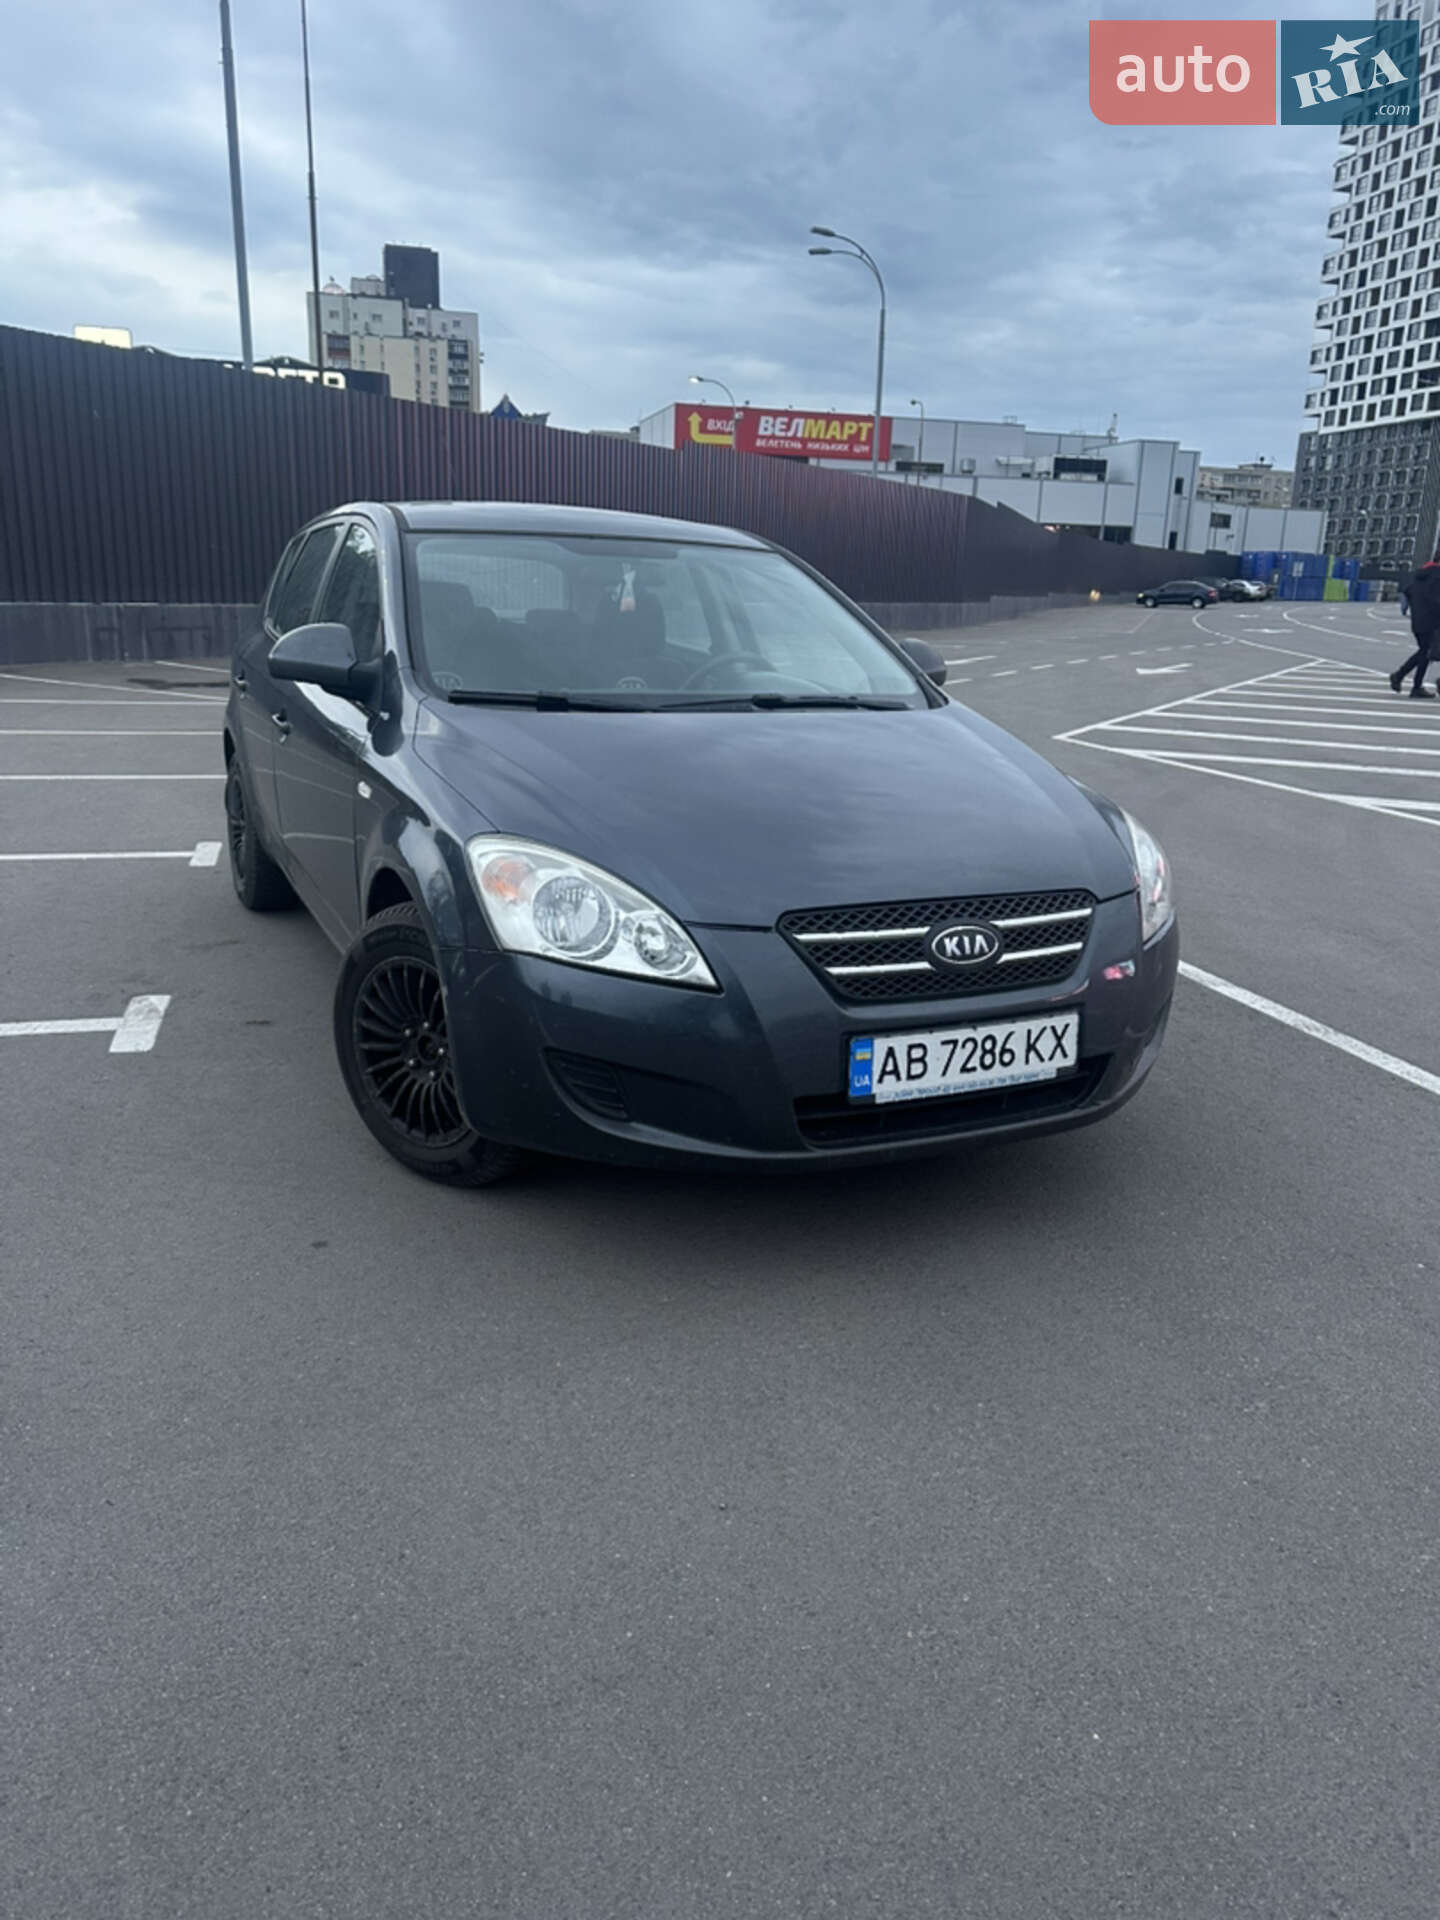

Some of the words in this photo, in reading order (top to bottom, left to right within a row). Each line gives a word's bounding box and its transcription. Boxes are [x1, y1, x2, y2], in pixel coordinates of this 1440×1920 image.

[758, 415, 873, 442] ВЕЛМАРТ
[944, 934, 989, 957] KIA
[877, 1042, 929, 1085] AB
[940, 1030, 1016, 1078] 7286
[1024, 1023, 1071, 1066] KX
[854, 1075, 871, 1088] UA
